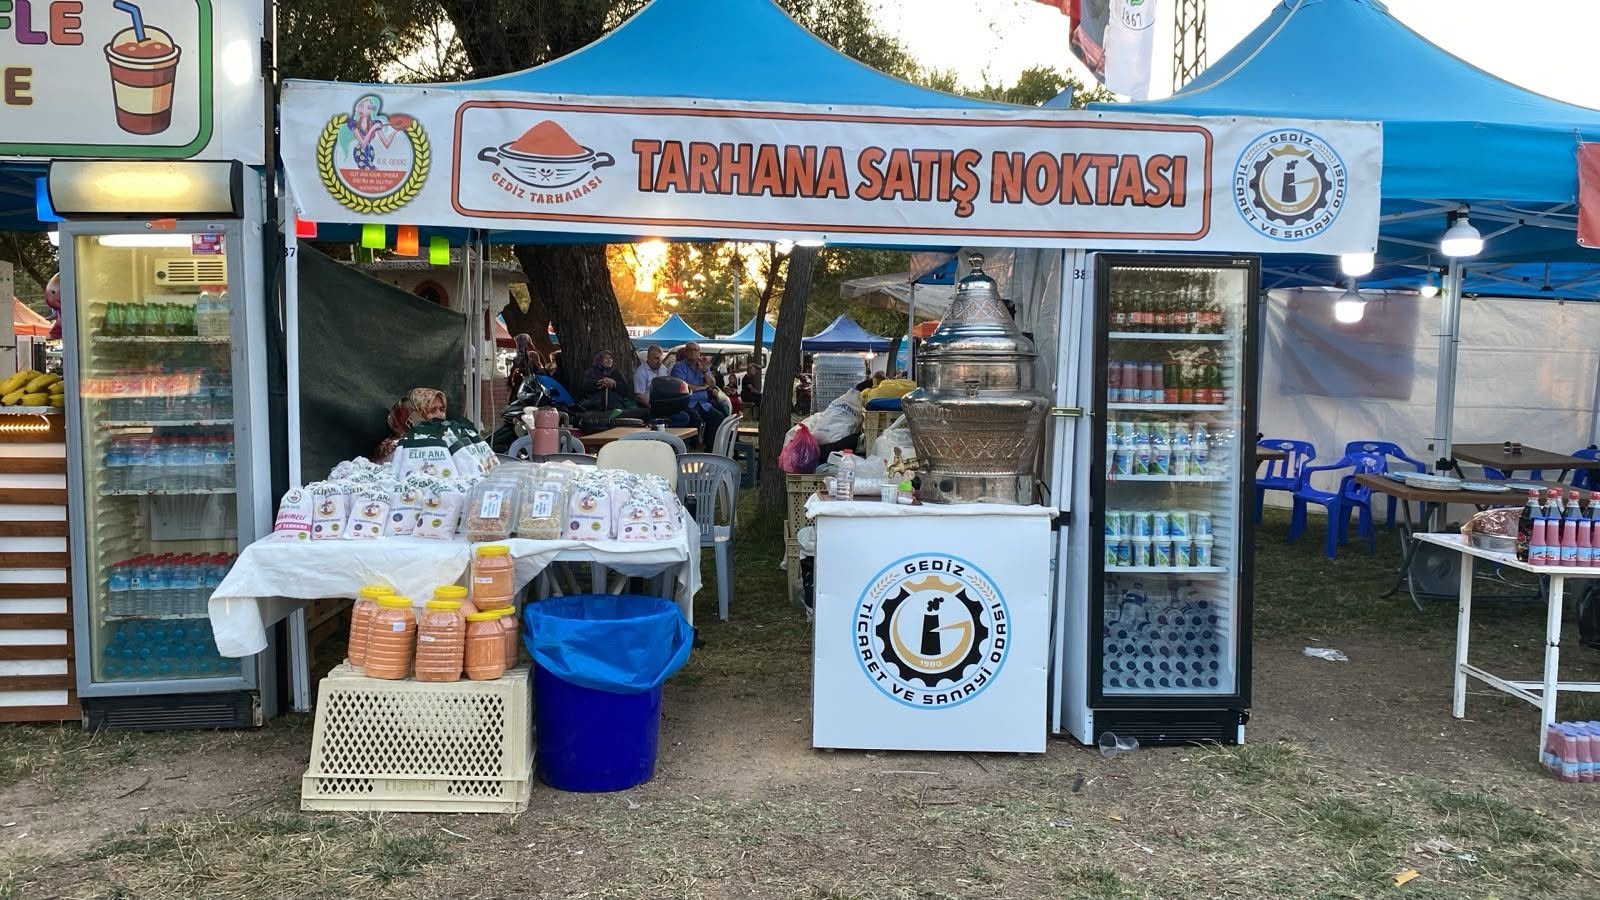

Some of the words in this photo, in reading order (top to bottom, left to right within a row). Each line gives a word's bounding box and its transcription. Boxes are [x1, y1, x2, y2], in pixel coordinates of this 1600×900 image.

[1122, 8, 1142, 27] 1867
[1269, 133, 1313, 146] GEDİZ
[491, 172, 526, 198] GEDİZ
[530, 176, 603, 204] TARHANASI
[632, 139, 850, 199] TARHANA
[855, 146, 982, 218] SATIŞ
[990, 150, 1188, 208] NOKTASI
[1236, 164, 1258, 222] TİCARET
[1261, 223, 1278, 236] VE
[1284, 210, 1334, 238] SANAYİ
[1333, 164, 1345, 208] ODASI
[904, 560, 965, 577] GEDİZ
[858, 603, 888, 682] TİCARET
[892, 683, 915, 701] VE
[923, 666, 992, 705] SANAYİ
[990, 603, 1006, 662] ODASI
[919, 659, 943, 668] 1980
